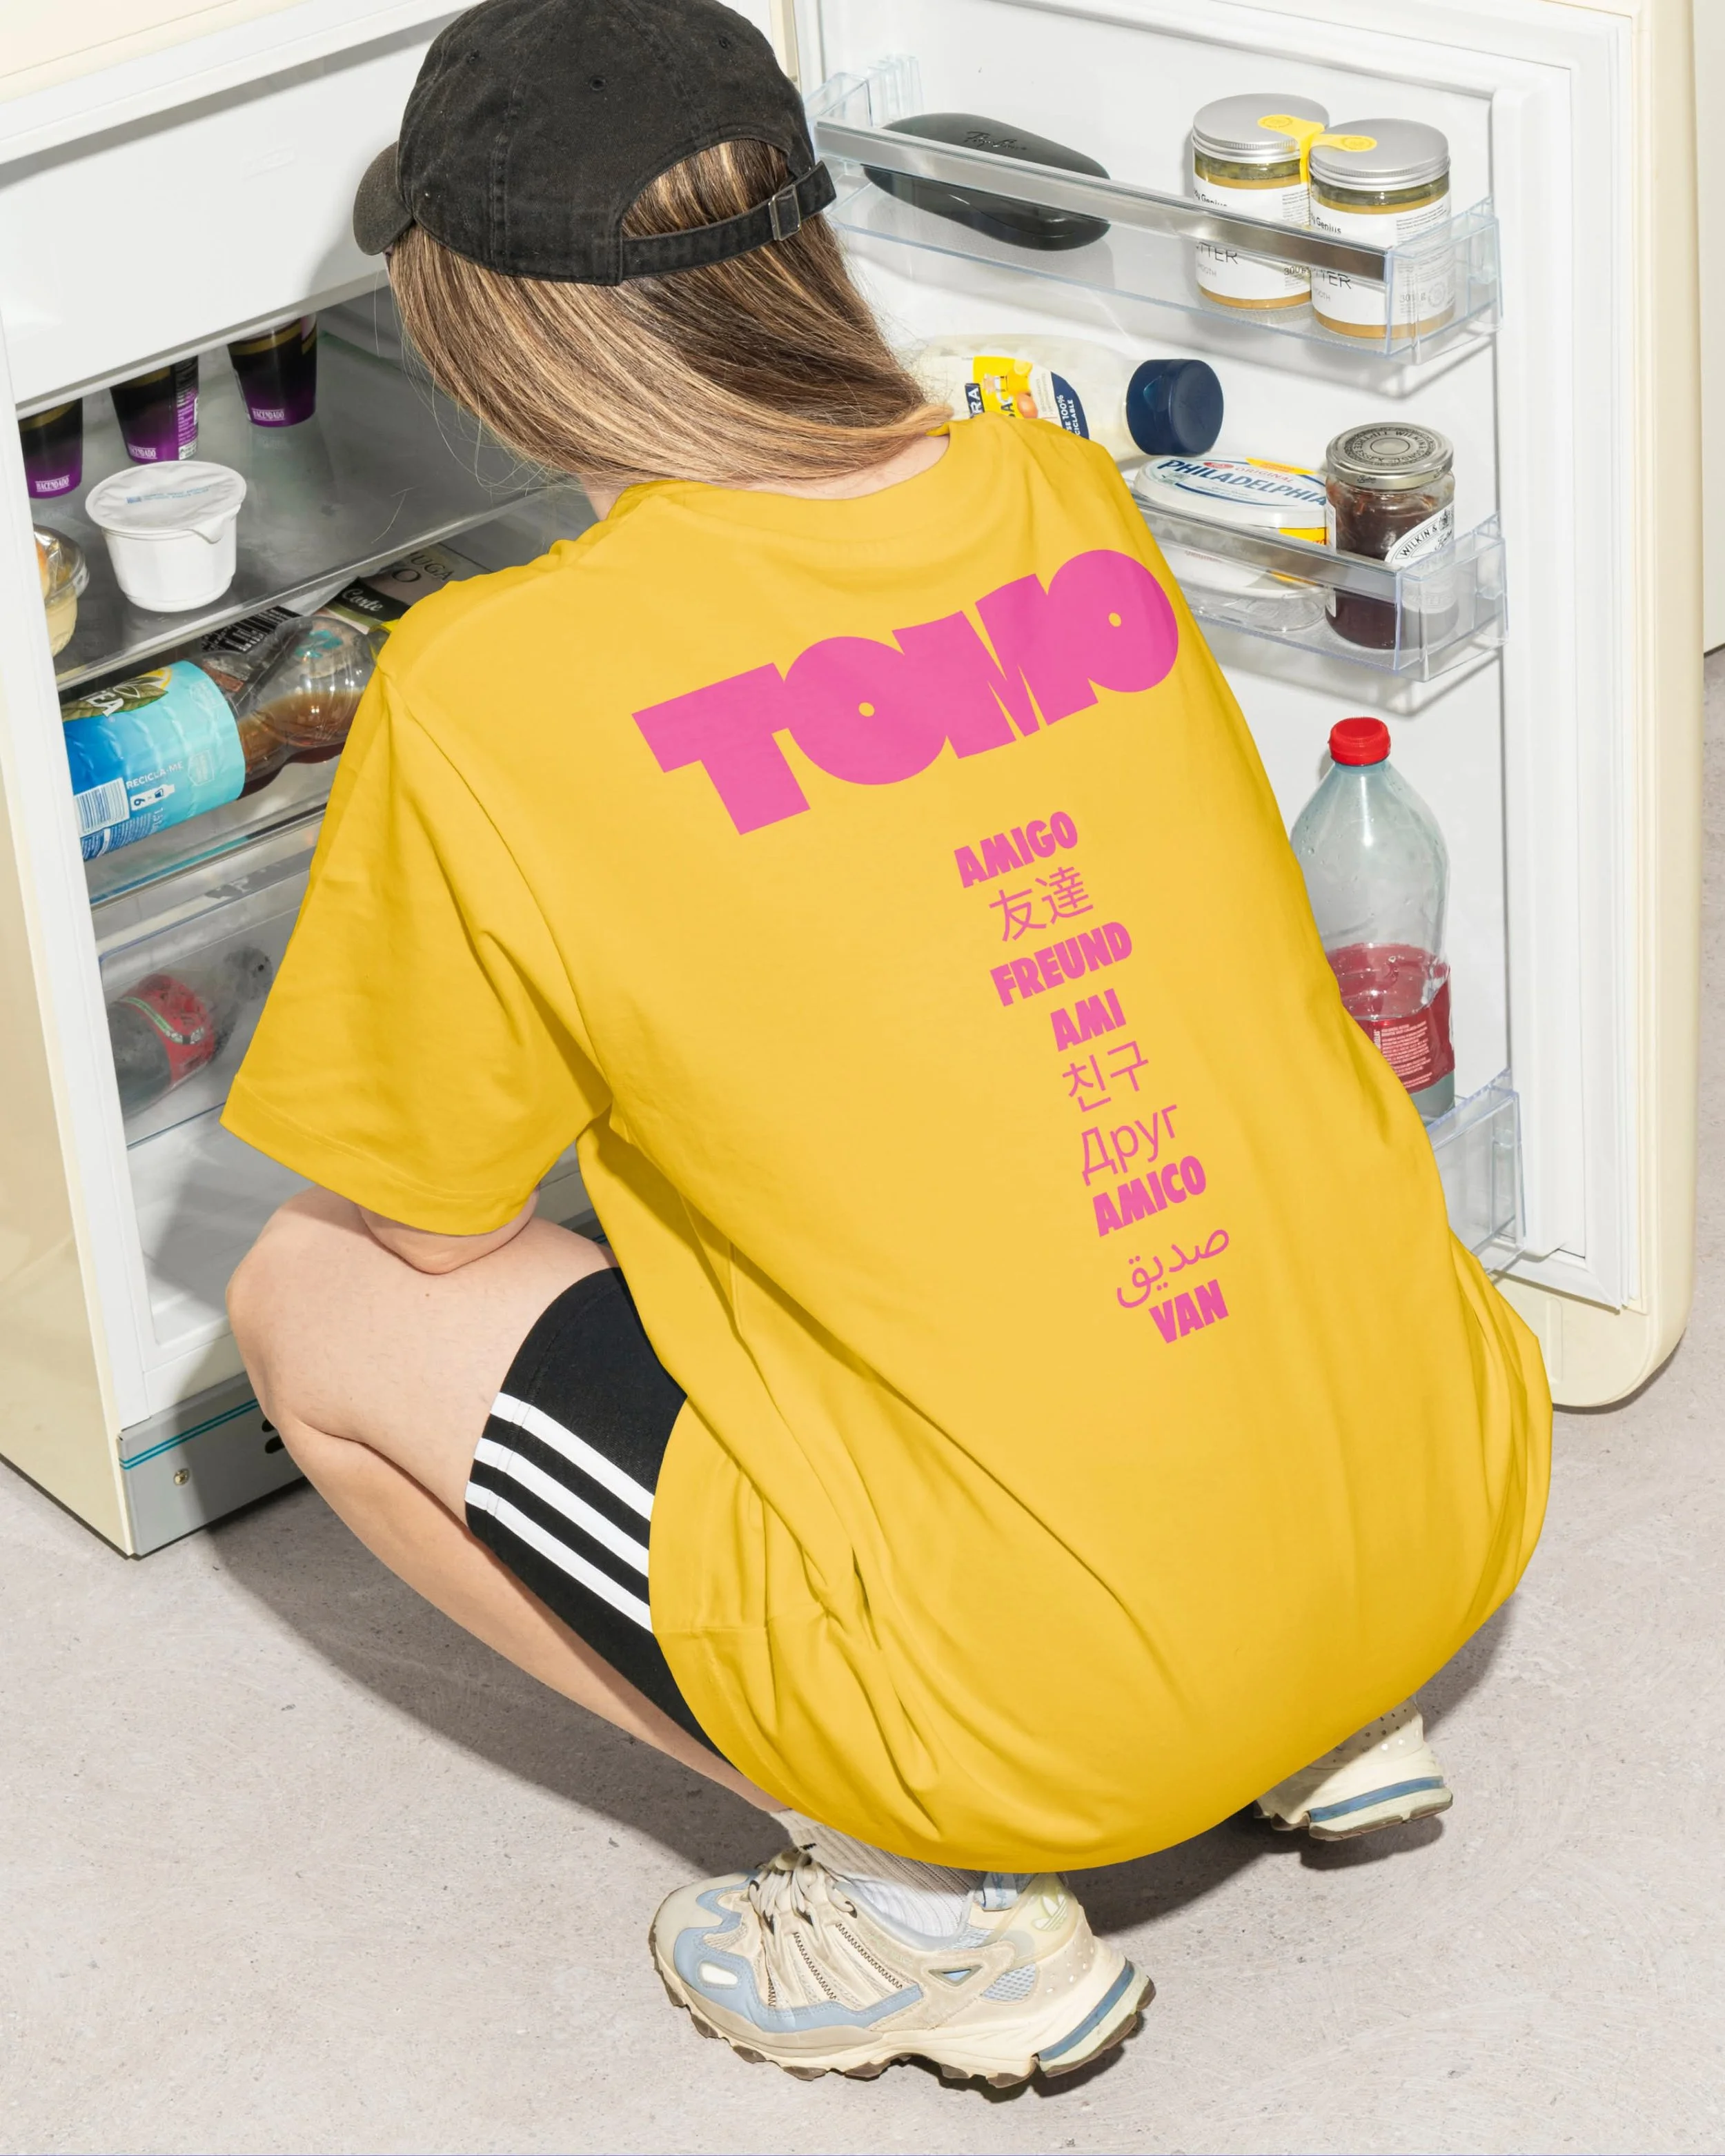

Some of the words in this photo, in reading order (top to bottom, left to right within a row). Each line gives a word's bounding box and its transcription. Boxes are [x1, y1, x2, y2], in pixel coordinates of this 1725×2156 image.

[1196, 241, 1239, 264] TTER
[1316, 217, 1341, 235] Genius
[1056, 395, 1070, 421] 100%
[1157, 460, 1327, 506] PHILADELPHIA
[1235, 467, 1294, 483] ORIGINAL
[1399, 529, 1430, 557] WILKIN
[632, 549, 1179, 835] TOMO
[954, 811, 1078, 888] AMIGO
[989, 867, 1094, 942] 友達
[990, 922, 1133, 1007] FREUND
[1050, 988, 1126, 1051] AMI
[1063, 1040, 1149, 1112] 친구
[1081, 1105, 1179, 1186] Друг
[1093, 1156, 1207, 1237] AMICO
[1116, 1229, 1230, 1309] صديق
[1149, 1280, 1229, 1344] VAN
